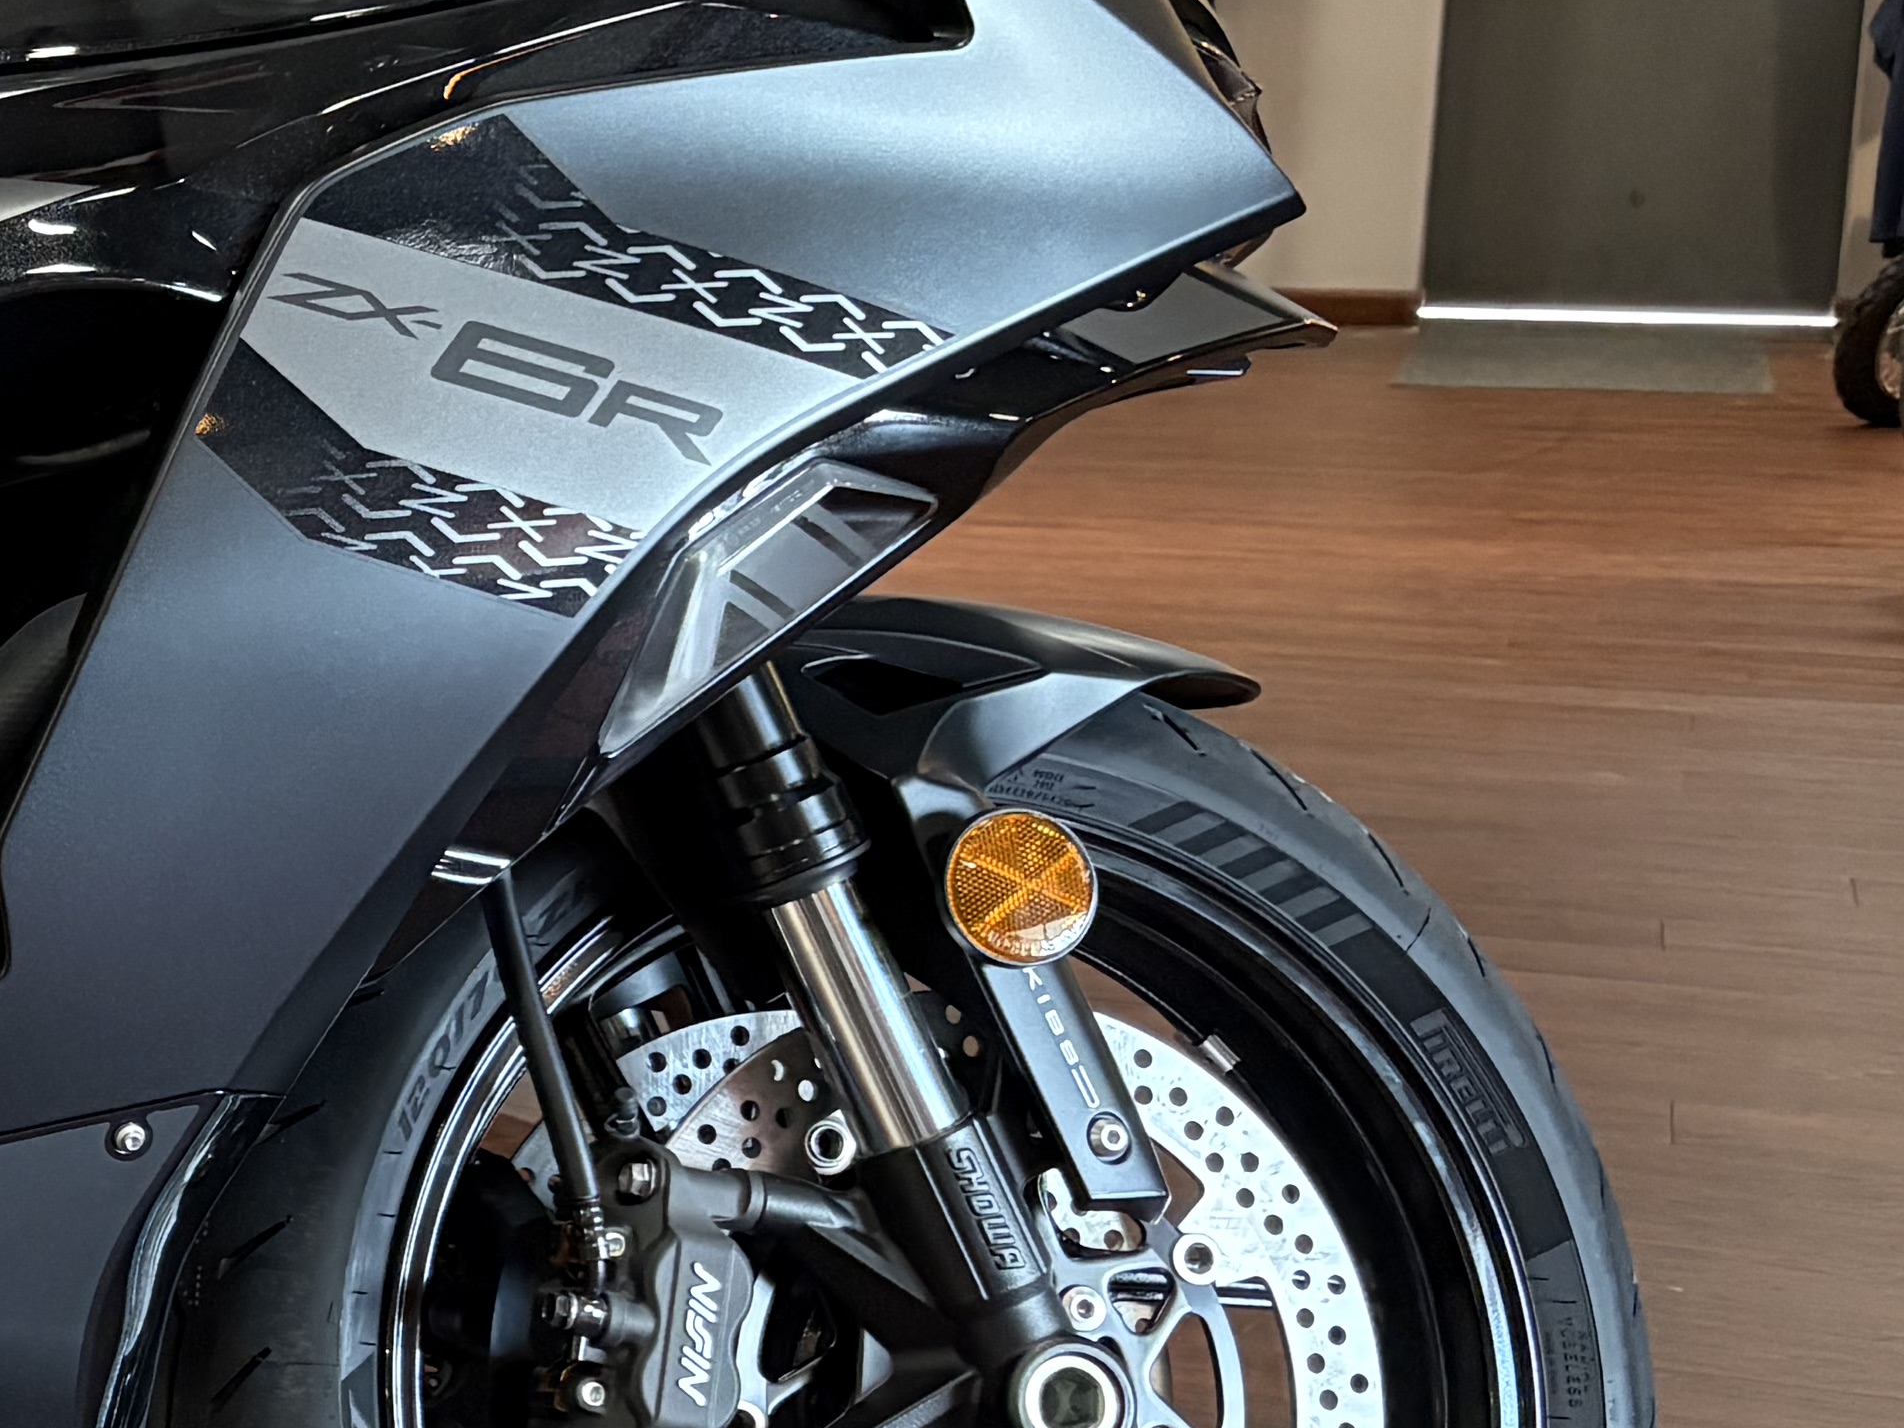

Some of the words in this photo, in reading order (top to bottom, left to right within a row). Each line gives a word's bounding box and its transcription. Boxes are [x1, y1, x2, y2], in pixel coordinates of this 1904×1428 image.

[269, 271, 724, 465] ZX-6R
[1409, 1008, 1532, 1155] PIRELLI
[943, 1144, 1026, 1272] SHOWA
